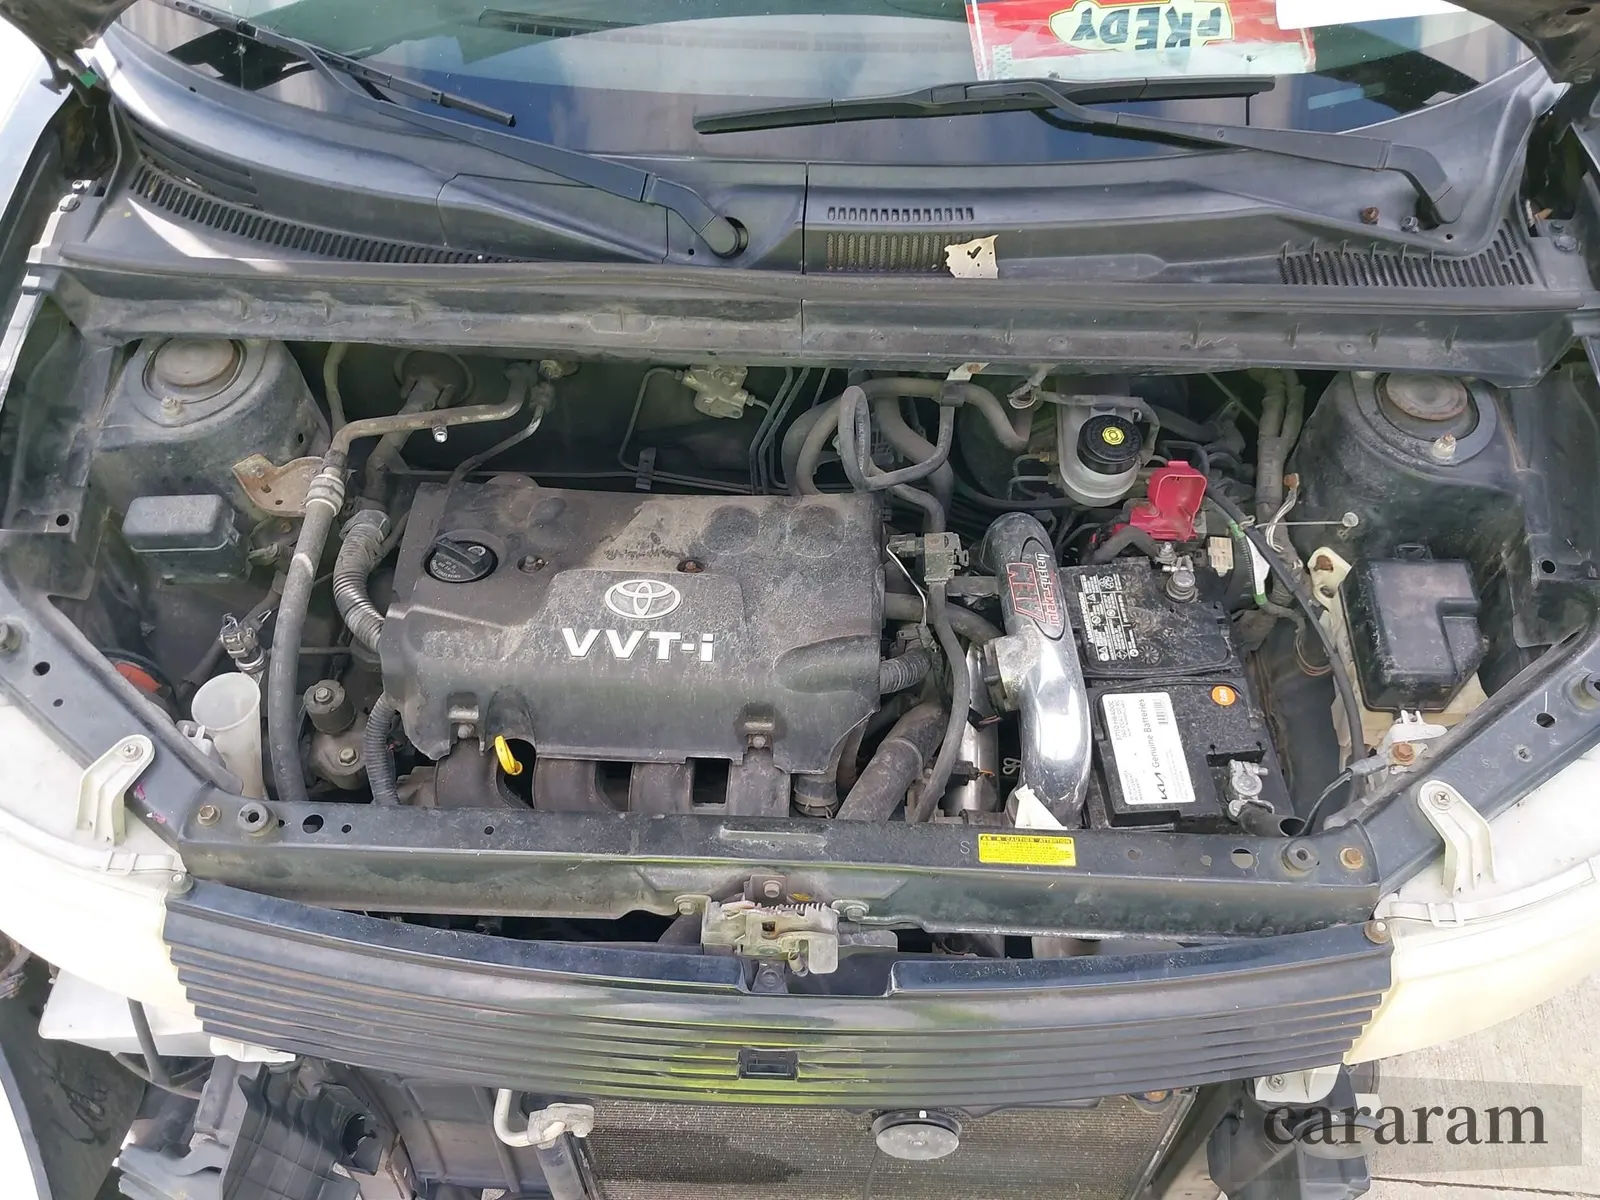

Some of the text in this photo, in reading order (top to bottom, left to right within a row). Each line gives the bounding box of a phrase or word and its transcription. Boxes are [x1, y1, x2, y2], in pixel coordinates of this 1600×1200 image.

[562, 628, 714, 662] VVT-i
[1138, 698, 1152, 733] Batteries
[1147, 734, 1160, 768] Genuine
